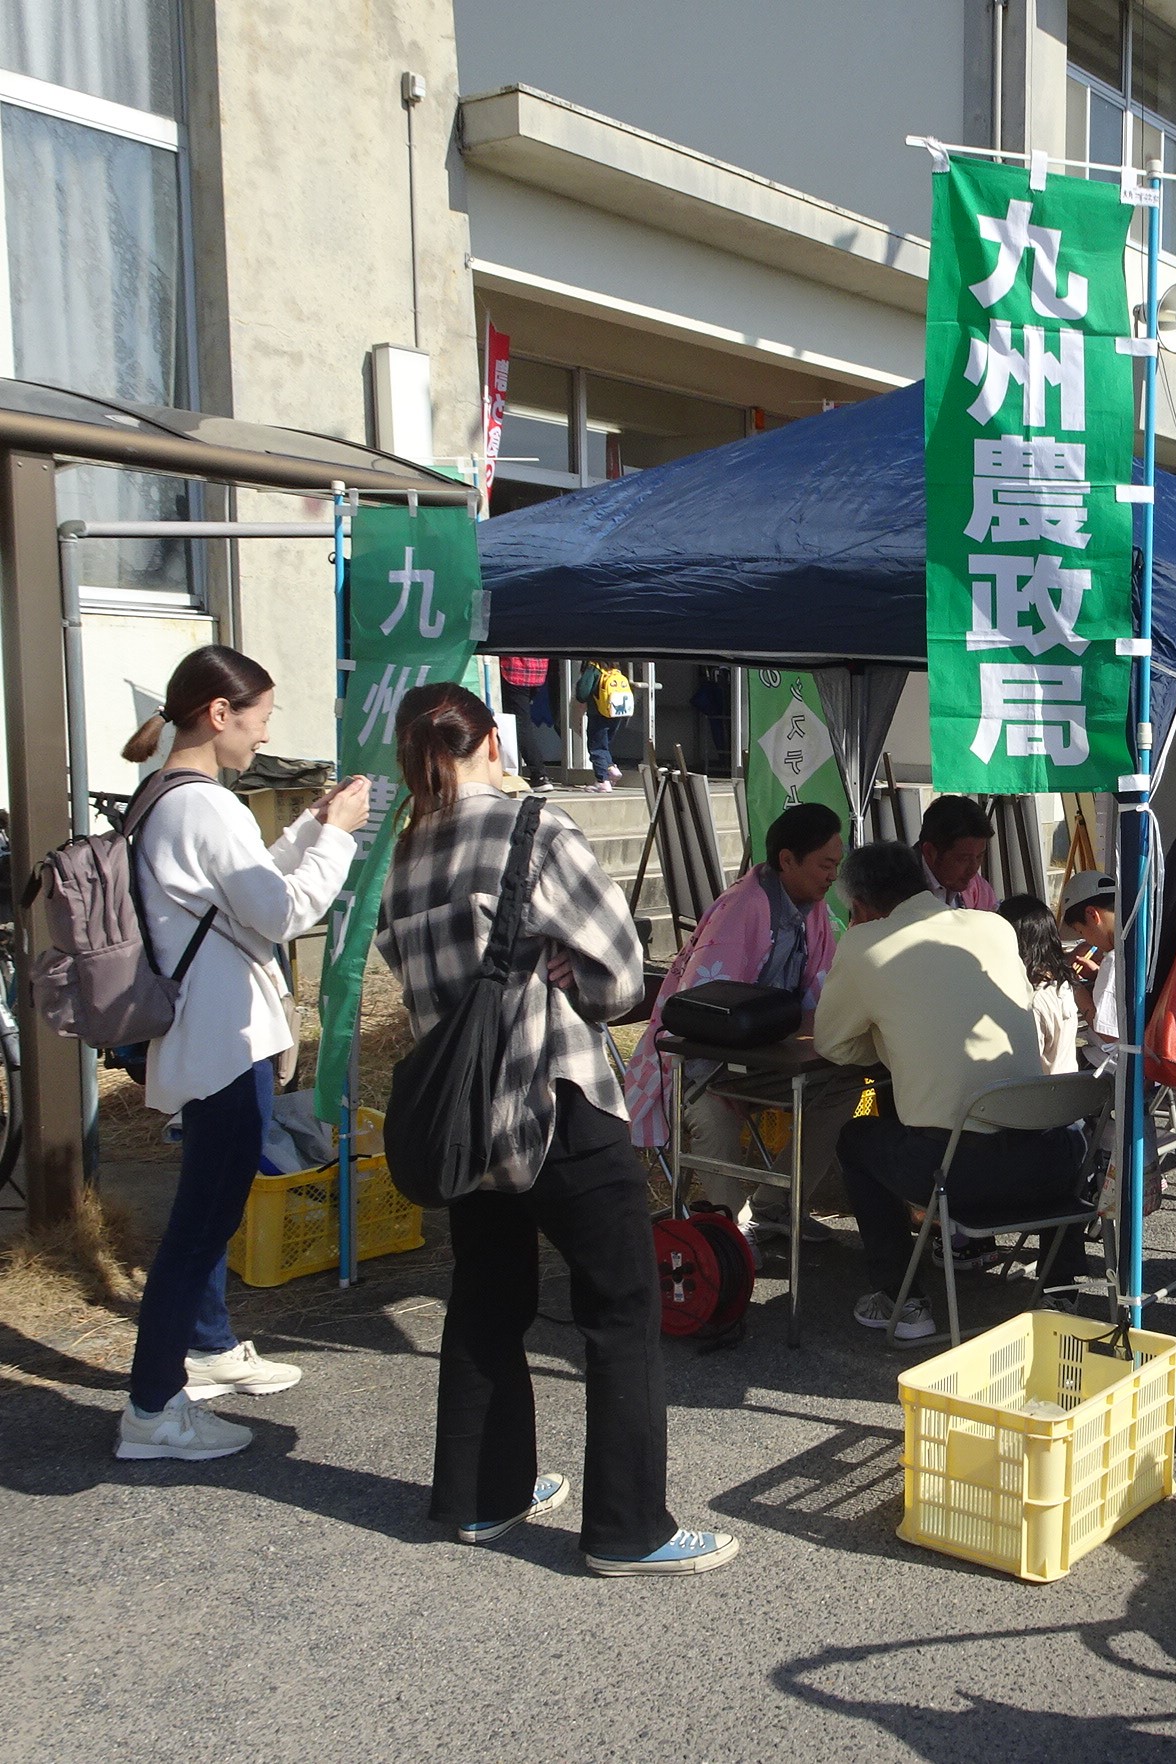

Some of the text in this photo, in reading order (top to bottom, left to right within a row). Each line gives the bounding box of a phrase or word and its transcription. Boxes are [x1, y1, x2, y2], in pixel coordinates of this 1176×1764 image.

[963, 198, 1092, 767] 九州農政局
